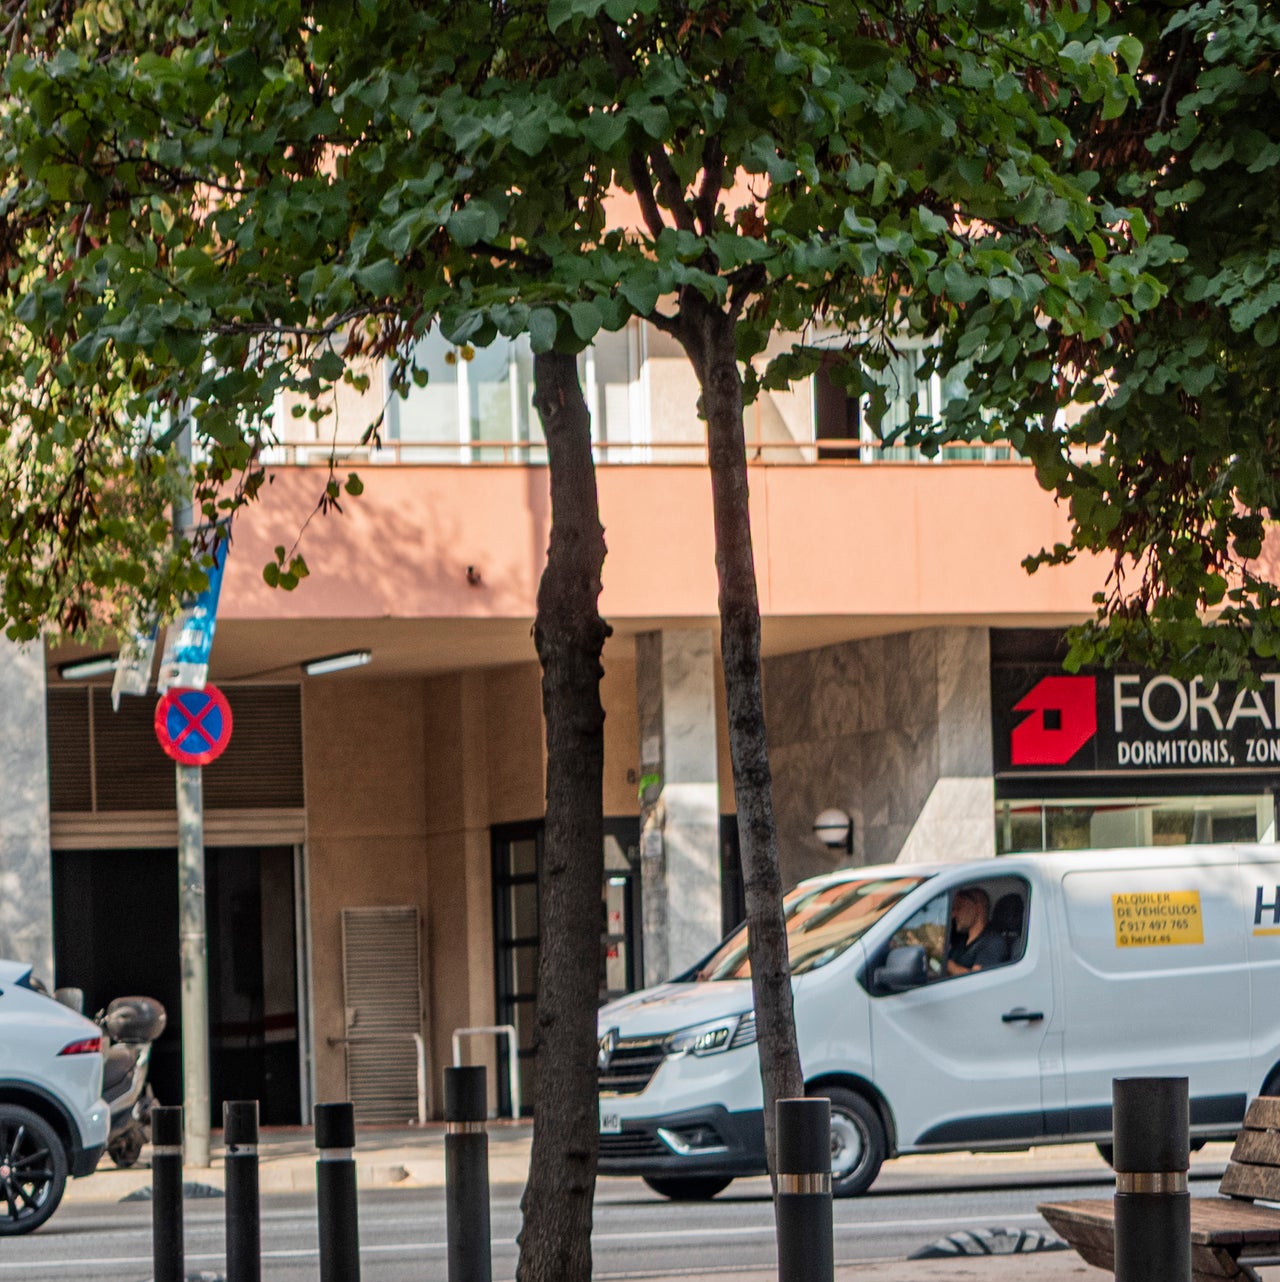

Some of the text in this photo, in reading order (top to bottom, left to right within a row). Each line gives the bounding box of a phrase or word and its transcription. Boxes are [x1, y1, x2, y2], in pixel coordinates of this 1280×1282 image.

[1117, 739, 1235, 766] DORMITORIS,
[1116, 893, 1170, 906] ALQUILER
[1117, 907, 1131, 918] DE
